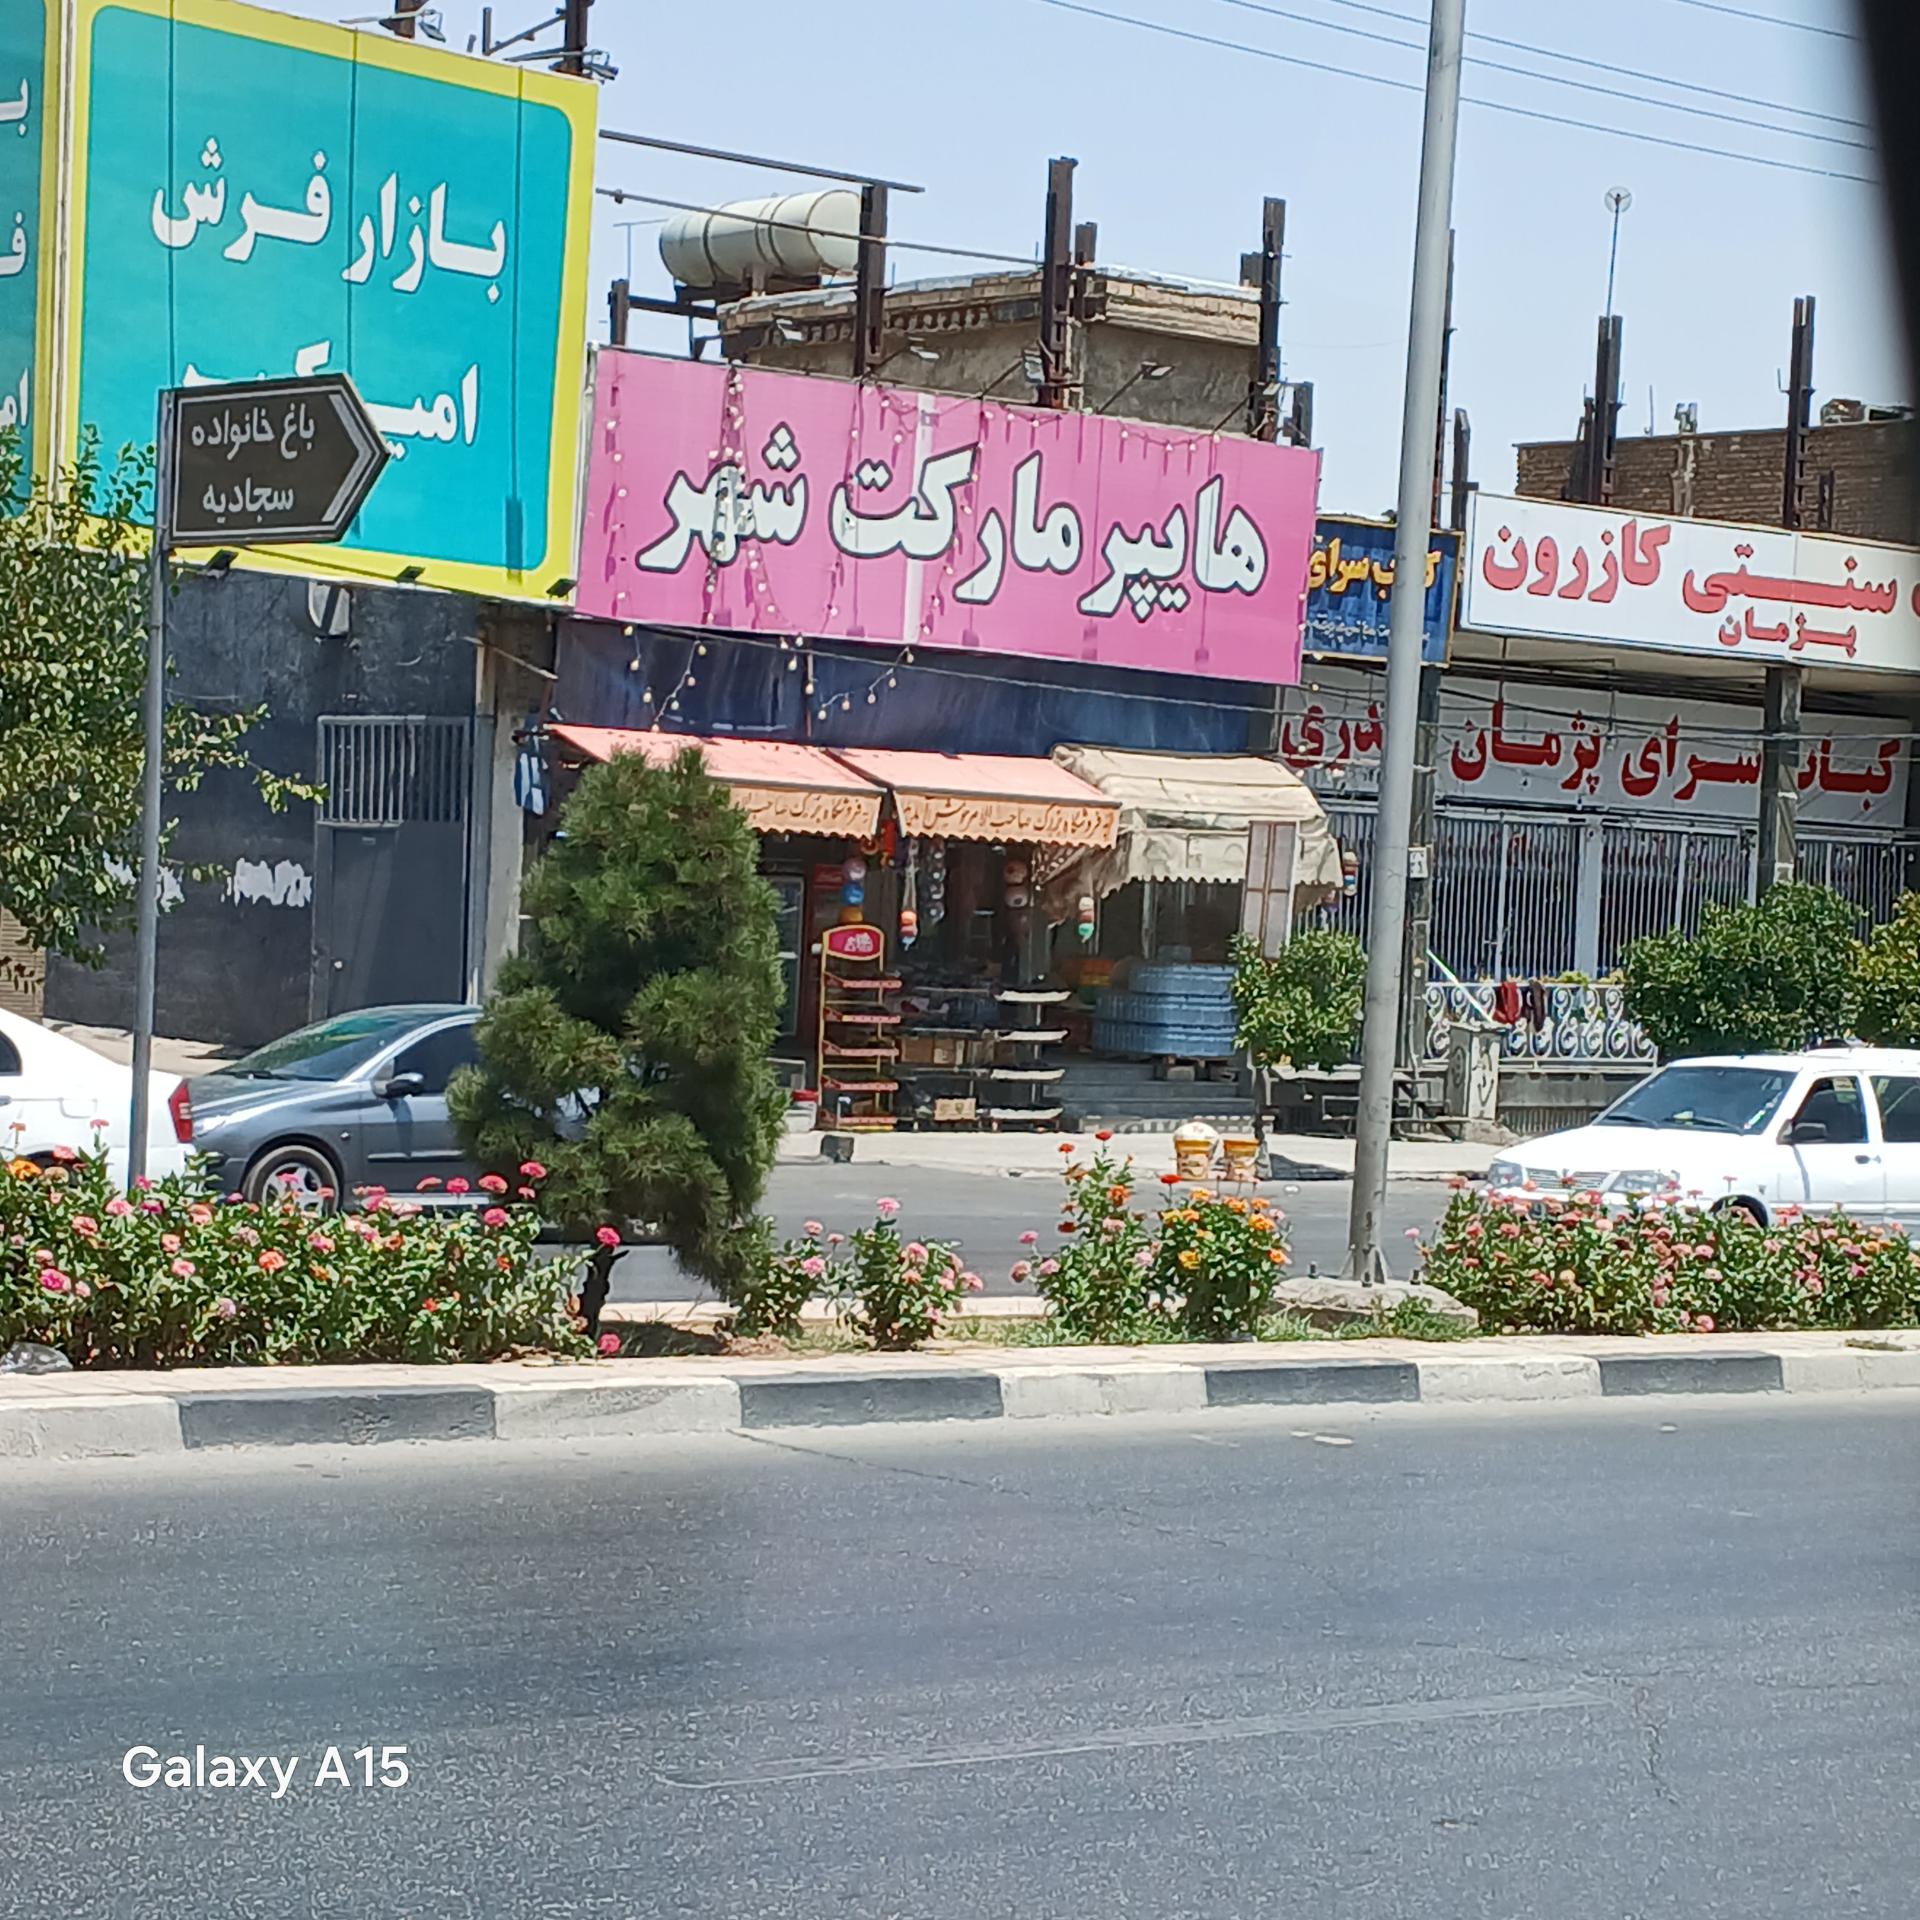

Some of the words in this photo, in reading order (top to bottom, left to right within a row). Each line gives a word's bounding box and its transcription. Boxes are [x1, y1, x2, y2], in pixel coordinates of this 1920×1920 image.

[151, 138, 331, 262] فرش
[341, 172, 505, 303] بازار
[190, 407, 275, 461] خانواده
[280, 403, 315, 459] باغ
[202, 477, 295, 525] سجادیه
[638, 422, 806, 572] شهر
[1078, 476, 1267, 622] هایپر
[1482, 518, 1671, 605] کازرون
[1682, 543, 1898, 615] سنتی
[1450, 699, 1601, 795] پژمان
[1620, 713, 1763, 801] سرای
[1033, 802, 1063, 837] بزرگ
[1063, 806, 1101, 839] فروشگاه
